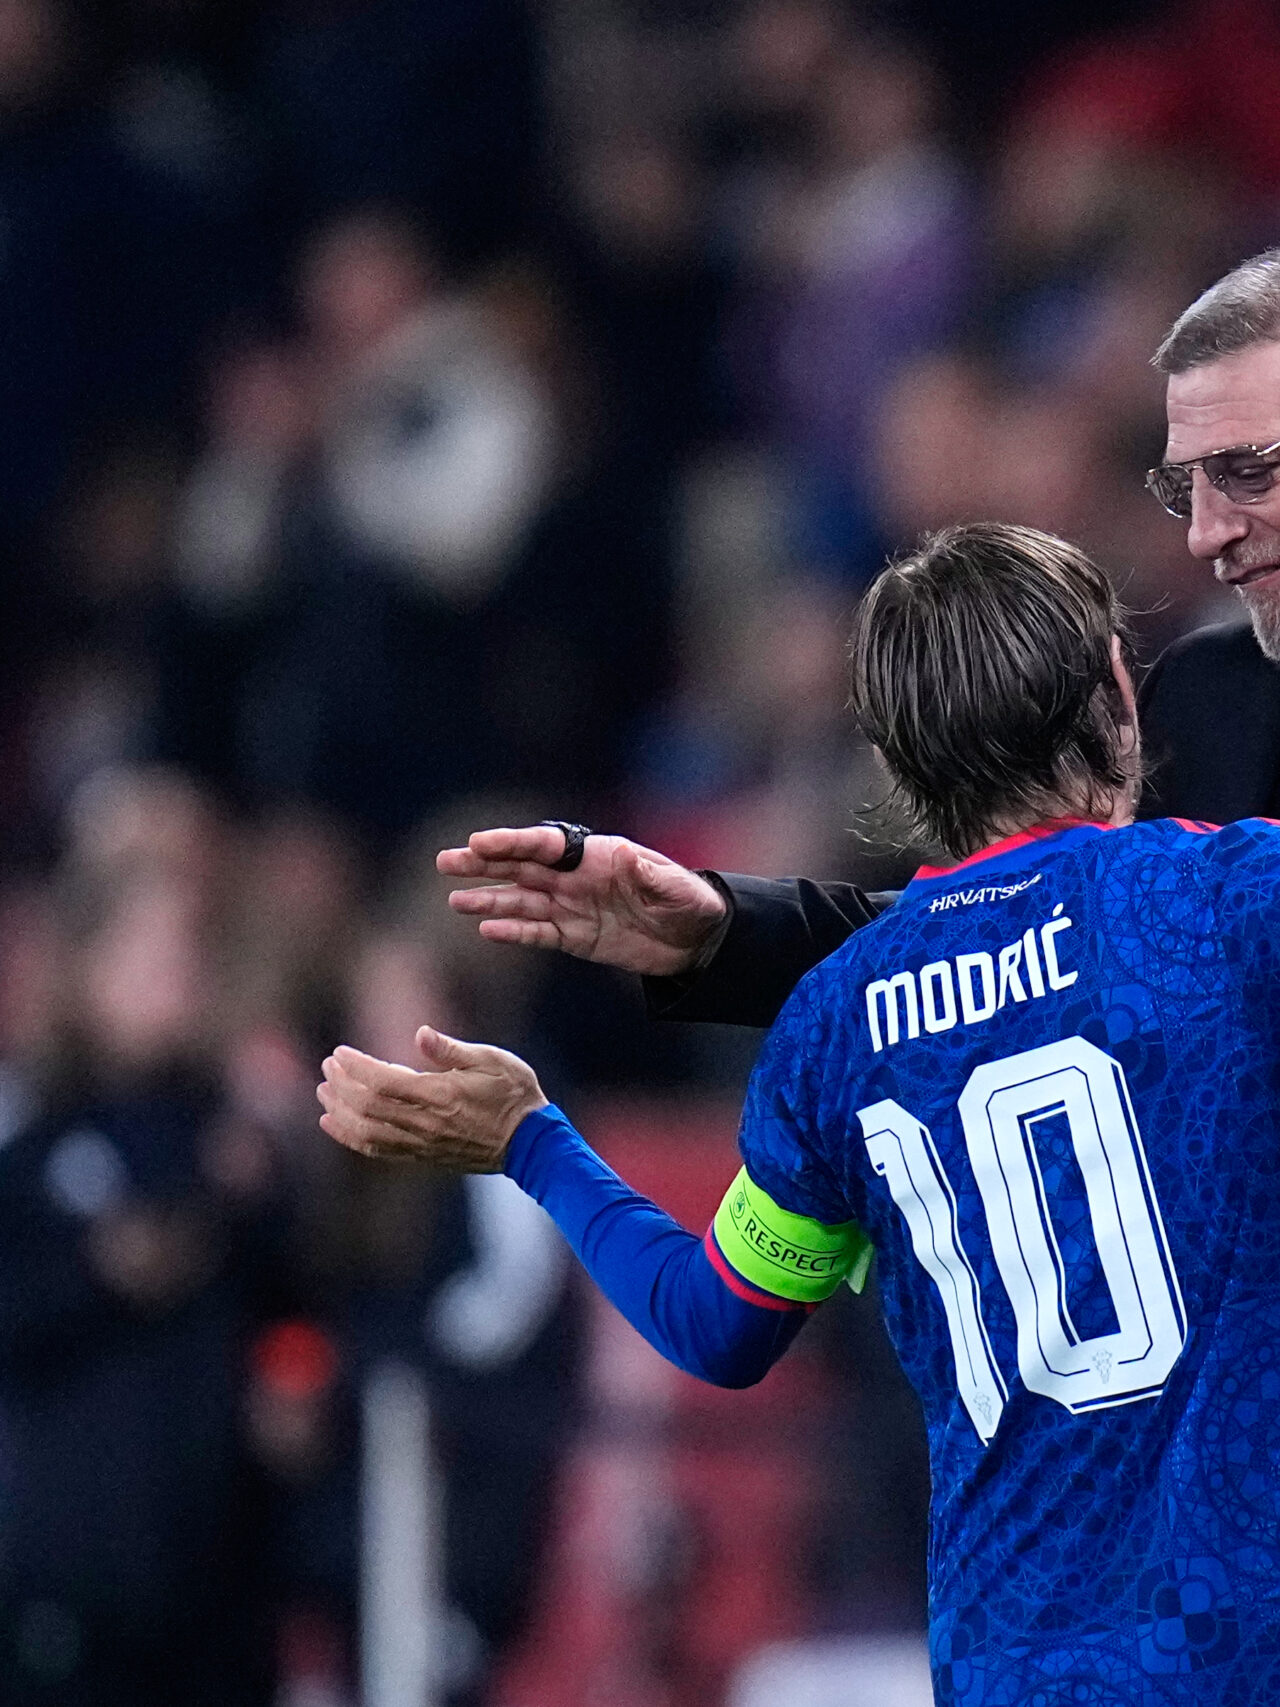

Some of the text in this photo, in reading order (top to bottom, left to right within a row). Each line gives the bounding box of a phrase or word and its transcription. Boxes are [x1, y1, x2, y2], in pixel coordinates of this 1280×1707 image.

[928, 873, 1042, 913] HRVATSKA
[865, 902, 1079, 1053] MODRIĆ
[744, 1217, 842, 1272] RESPECT
[855, 1035, 1188, 1447] 10
